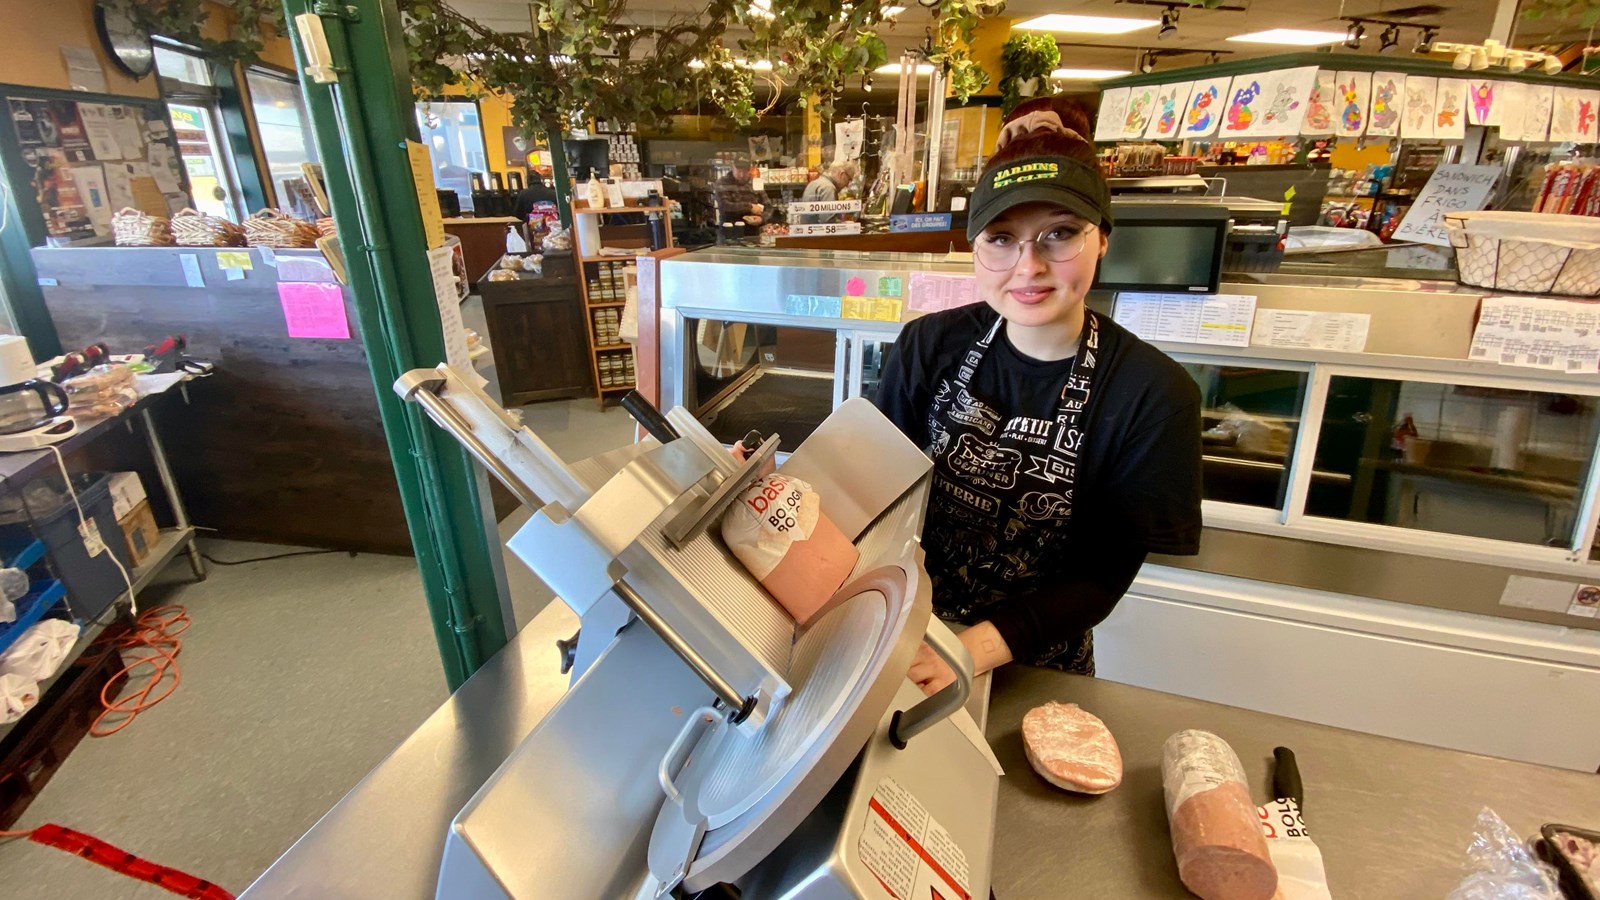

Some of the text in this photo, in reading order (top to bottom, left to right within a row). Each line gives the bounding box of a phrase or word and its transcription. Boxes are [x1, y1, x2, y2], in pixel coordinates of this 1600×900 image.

[993, 162, 1058, 182] JARDINS
[1433, 170, 1495, 186] SANDWICH
[1432, 184, 1470, 195] DANS
[809, 204, 820, 212] 20
[1421, 195, 1467, 209] FRIGO
[807, 226, 813, 234] 5
[825, 225, 837, 234] 58
